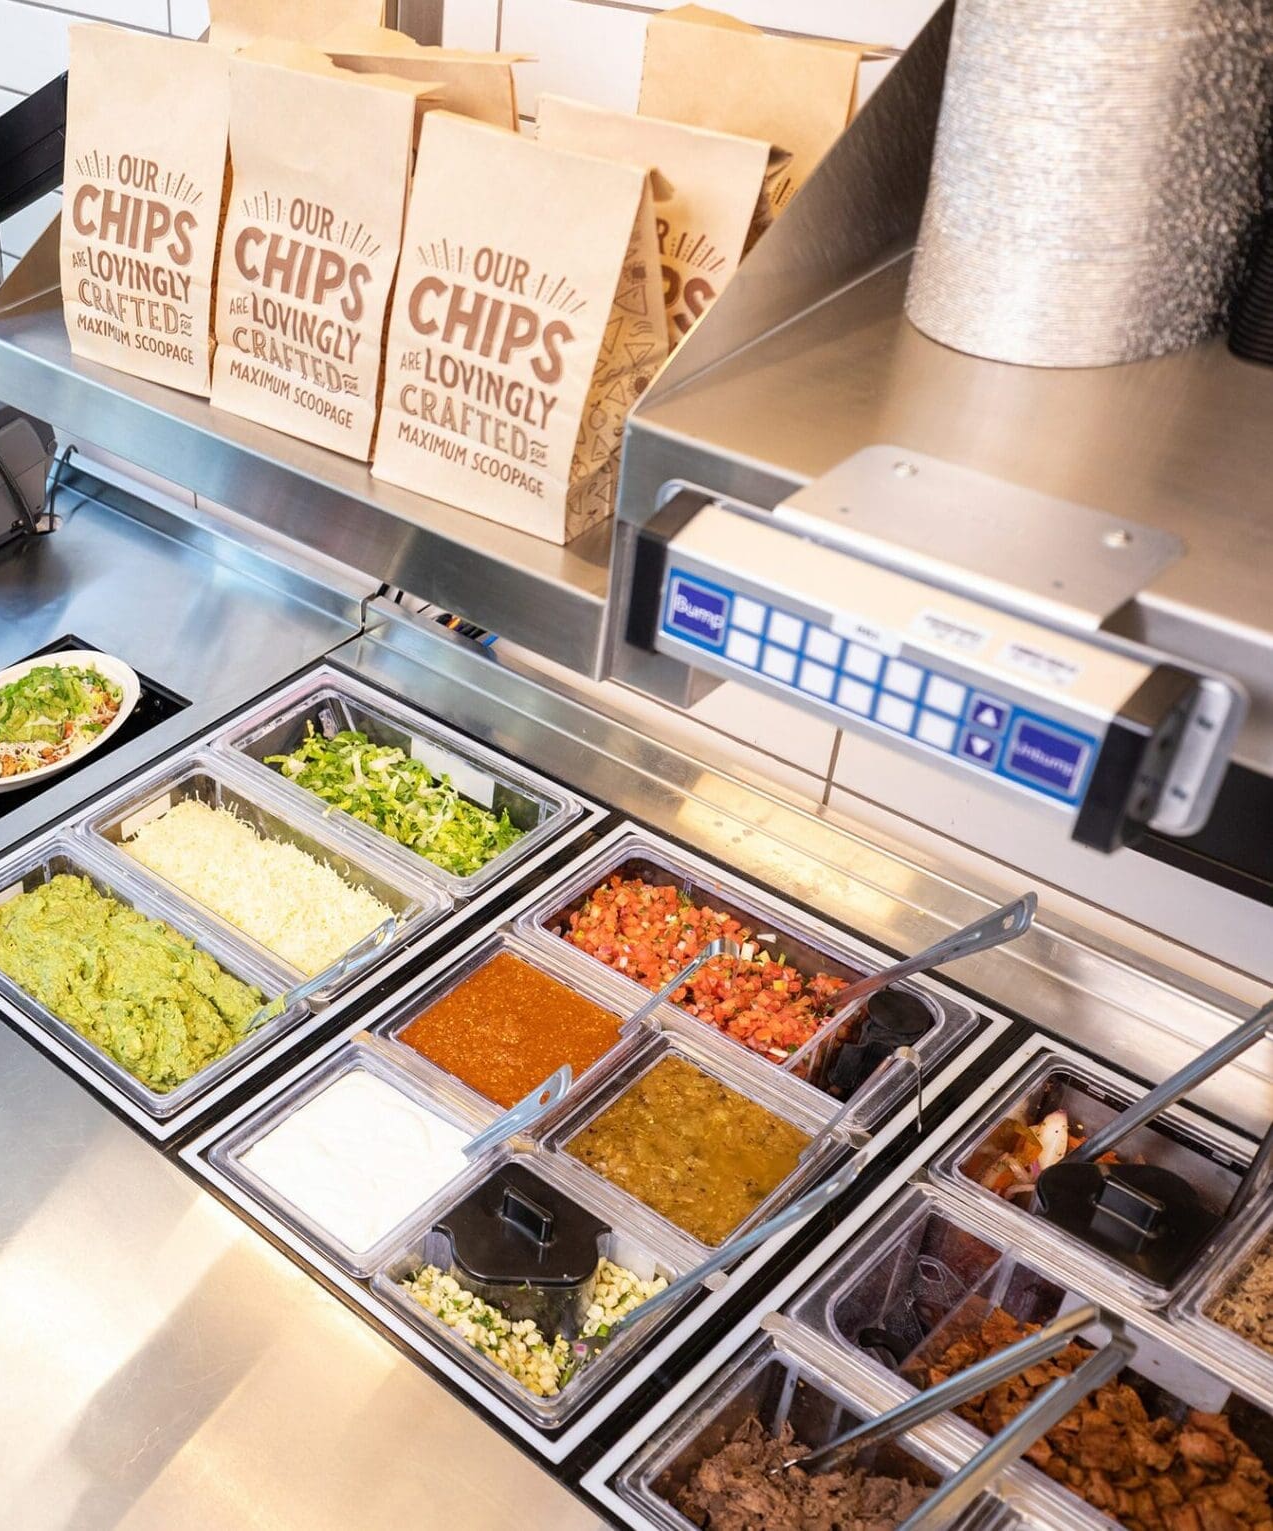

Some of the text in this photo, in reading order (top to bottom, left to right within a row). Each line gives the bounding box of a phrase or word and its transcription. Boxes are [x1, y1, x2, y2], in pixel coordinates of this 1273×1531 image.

[118, 154, 160, 193] OUR
[72, 184, 198, 267] CHIPS
[289, 198, 335, 239] OUR
[72, 247, 191, 305] ARE LOVINGLY
[234, 226, 373, 322] CHIPS
[473, 247, 530, 295] OUR
[77, 313, 194, 366] MAXIMUM SCOOPAGE
[78, 278, 192, 335] CRAFTED FOR
[229, 292, 361, 365] ARE LOVINGLY
[408, 276, 575, 384] CHIPS
[232, 327, 359, 394] CRAFTED FOR
[399, 347, 559, 430] ARE LOVINGLY
[230, 360, 354, 430] MAXIMUM SCOOPAGE
[399, 384, 547, 462] CRAFTED FOR
[398, 422, 544, 499] MAXIMUM SCOOPAGE
[674, 594, 726, 631] Bump
